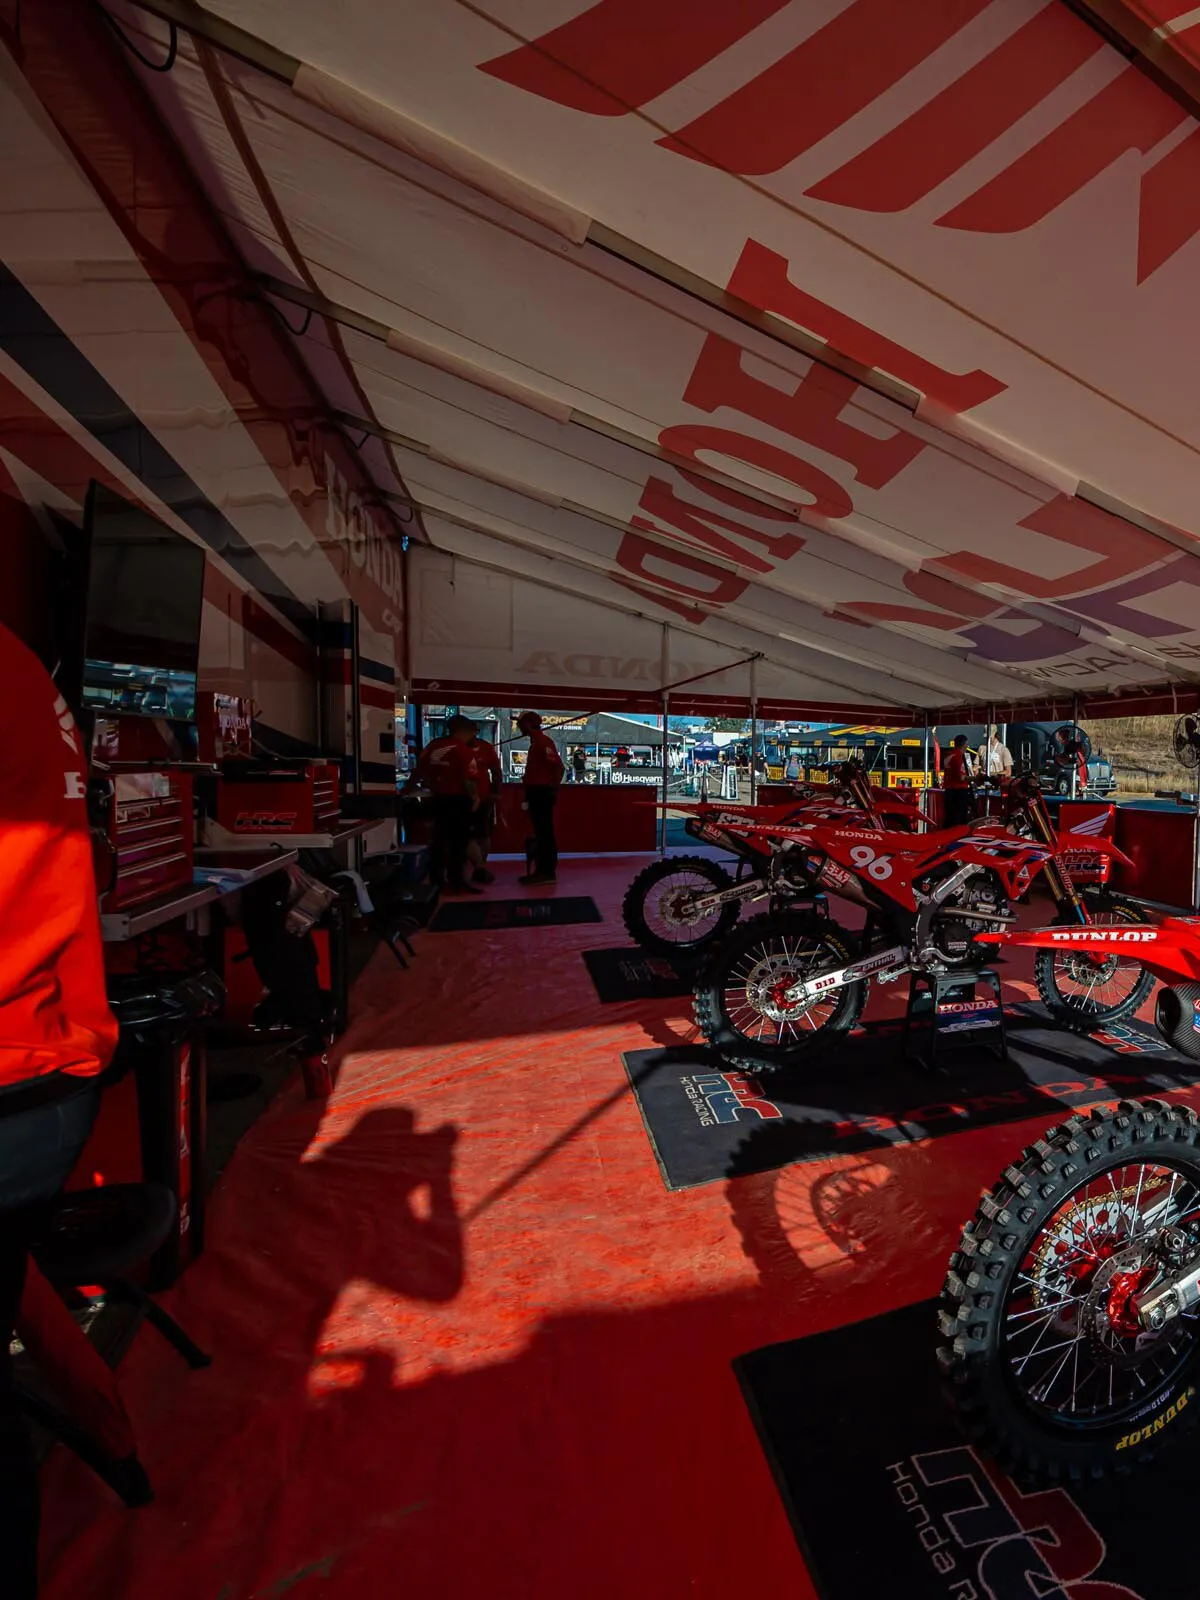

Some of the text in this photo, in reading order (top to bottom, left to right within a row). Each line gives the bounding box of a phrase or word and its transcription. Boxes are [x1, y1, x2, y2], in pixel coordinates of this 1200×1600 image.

[835, 830, 883, 841] HONDA
[850, 845, 893, 881] 96
[1052, 931, 1157, 942] DUNLOP
[939, 999, 997, 1015] HONDA
[1115, 1391, 1189, 1451] DUNLOP
